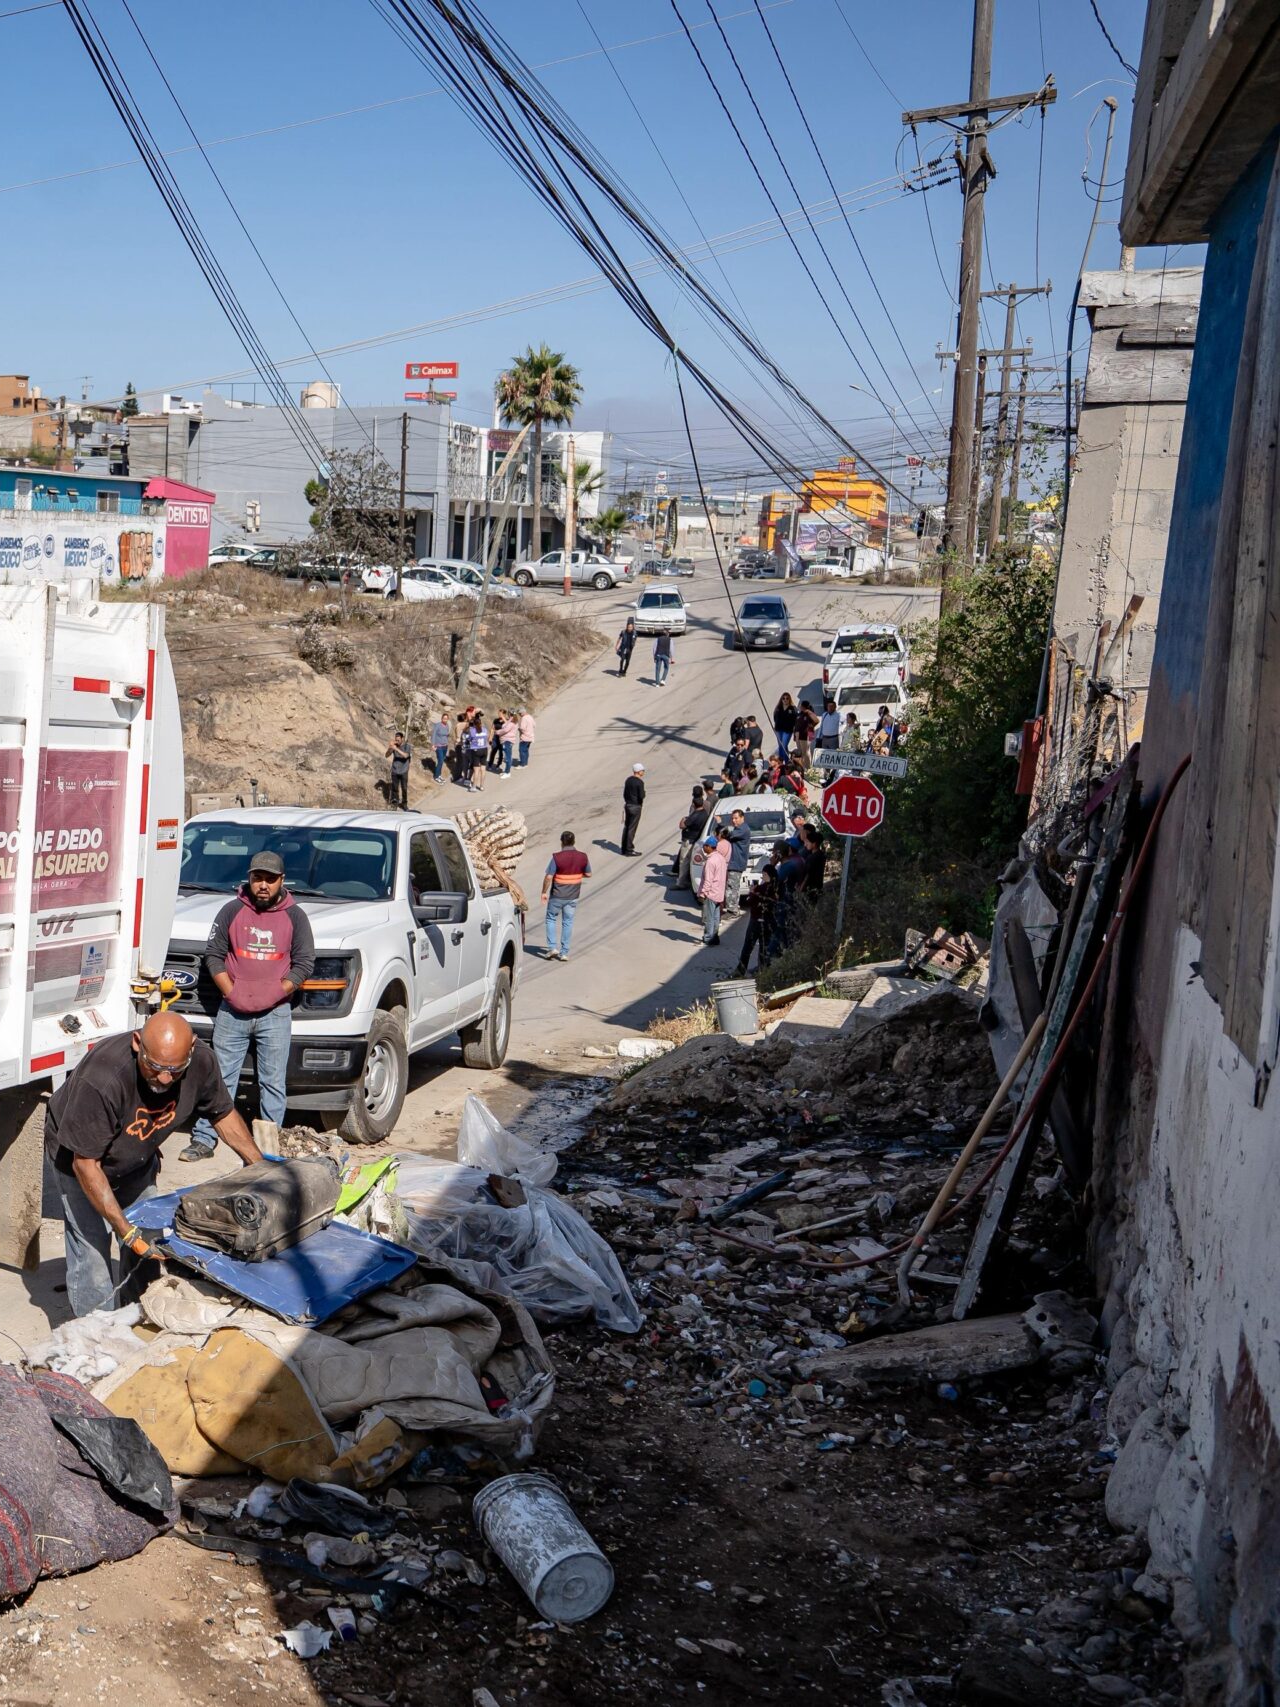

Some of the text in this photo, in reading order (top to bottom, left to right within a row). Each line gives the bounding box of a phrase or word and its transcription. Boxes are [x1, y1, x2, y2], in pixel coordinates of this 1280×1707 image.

[421, 366, 453, 376] Calimax
[167, 505, 209, 524] DENTISTA
[64, 537, 90, 550] CAMBIEMOS
[820, 753, 899, 772] FRANCISCO ZARCO
[825, 793, 880, 819] ALTO
[56, 828, 103, 851] DEDO
[41, 911, 80, 937] 072
